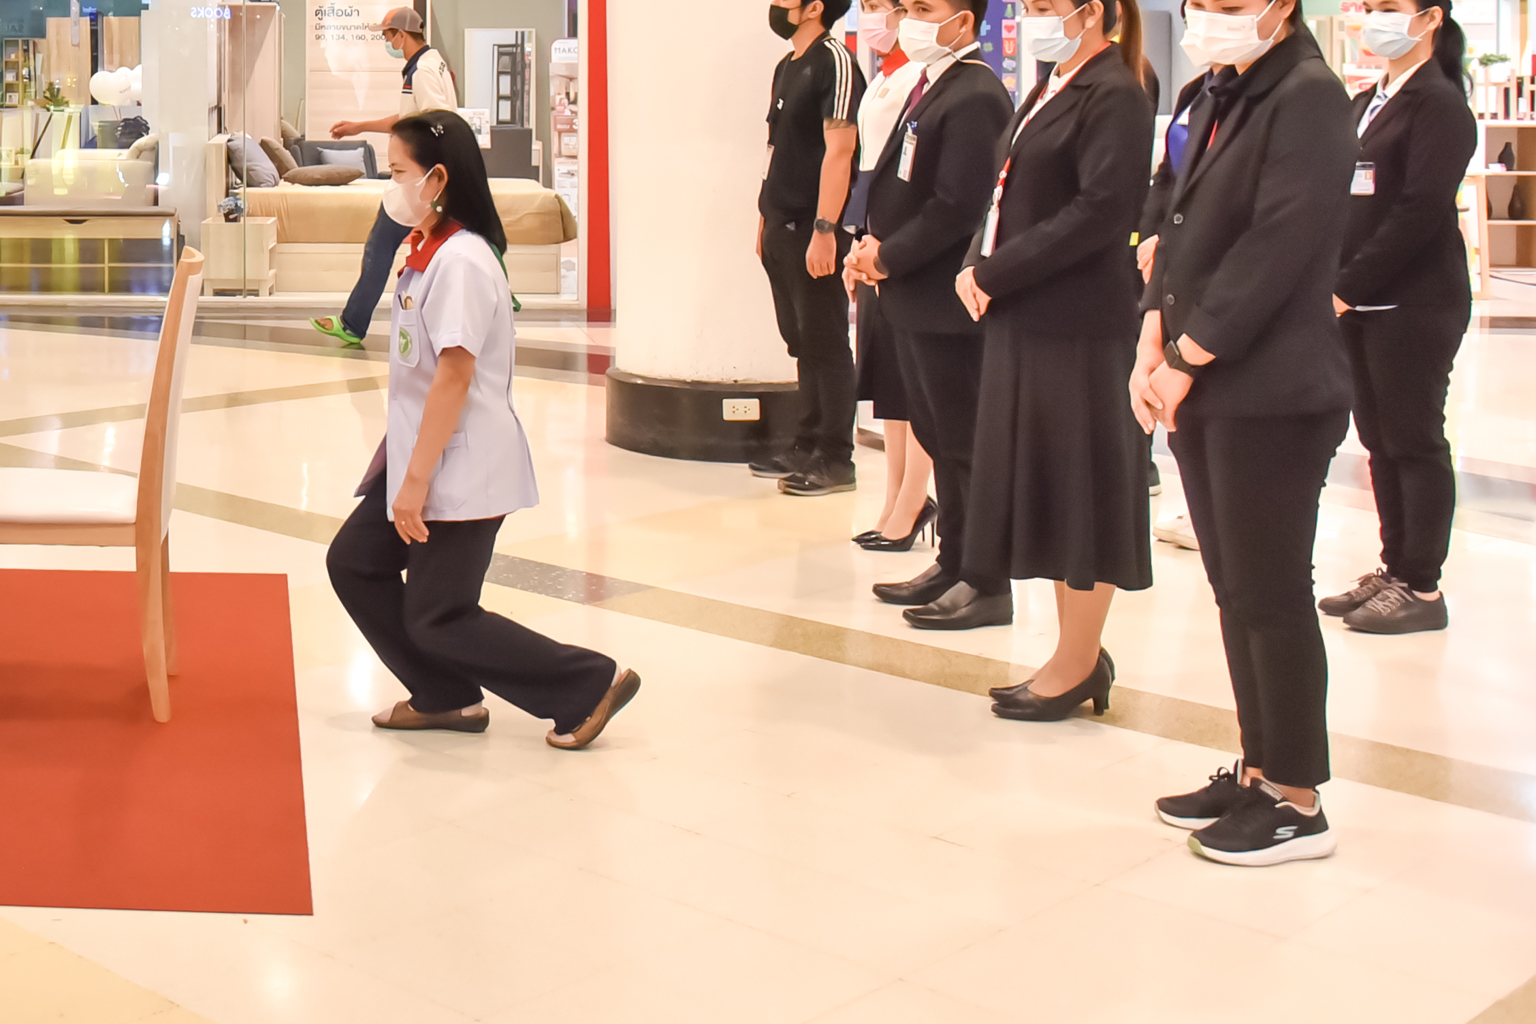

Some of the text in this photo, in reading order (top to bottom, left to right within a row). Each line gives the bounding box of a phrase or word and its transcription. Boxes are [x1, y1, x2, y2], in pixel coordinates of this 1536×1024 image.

[314, 2, 360, 21] ตู้เสื้อผ้า
